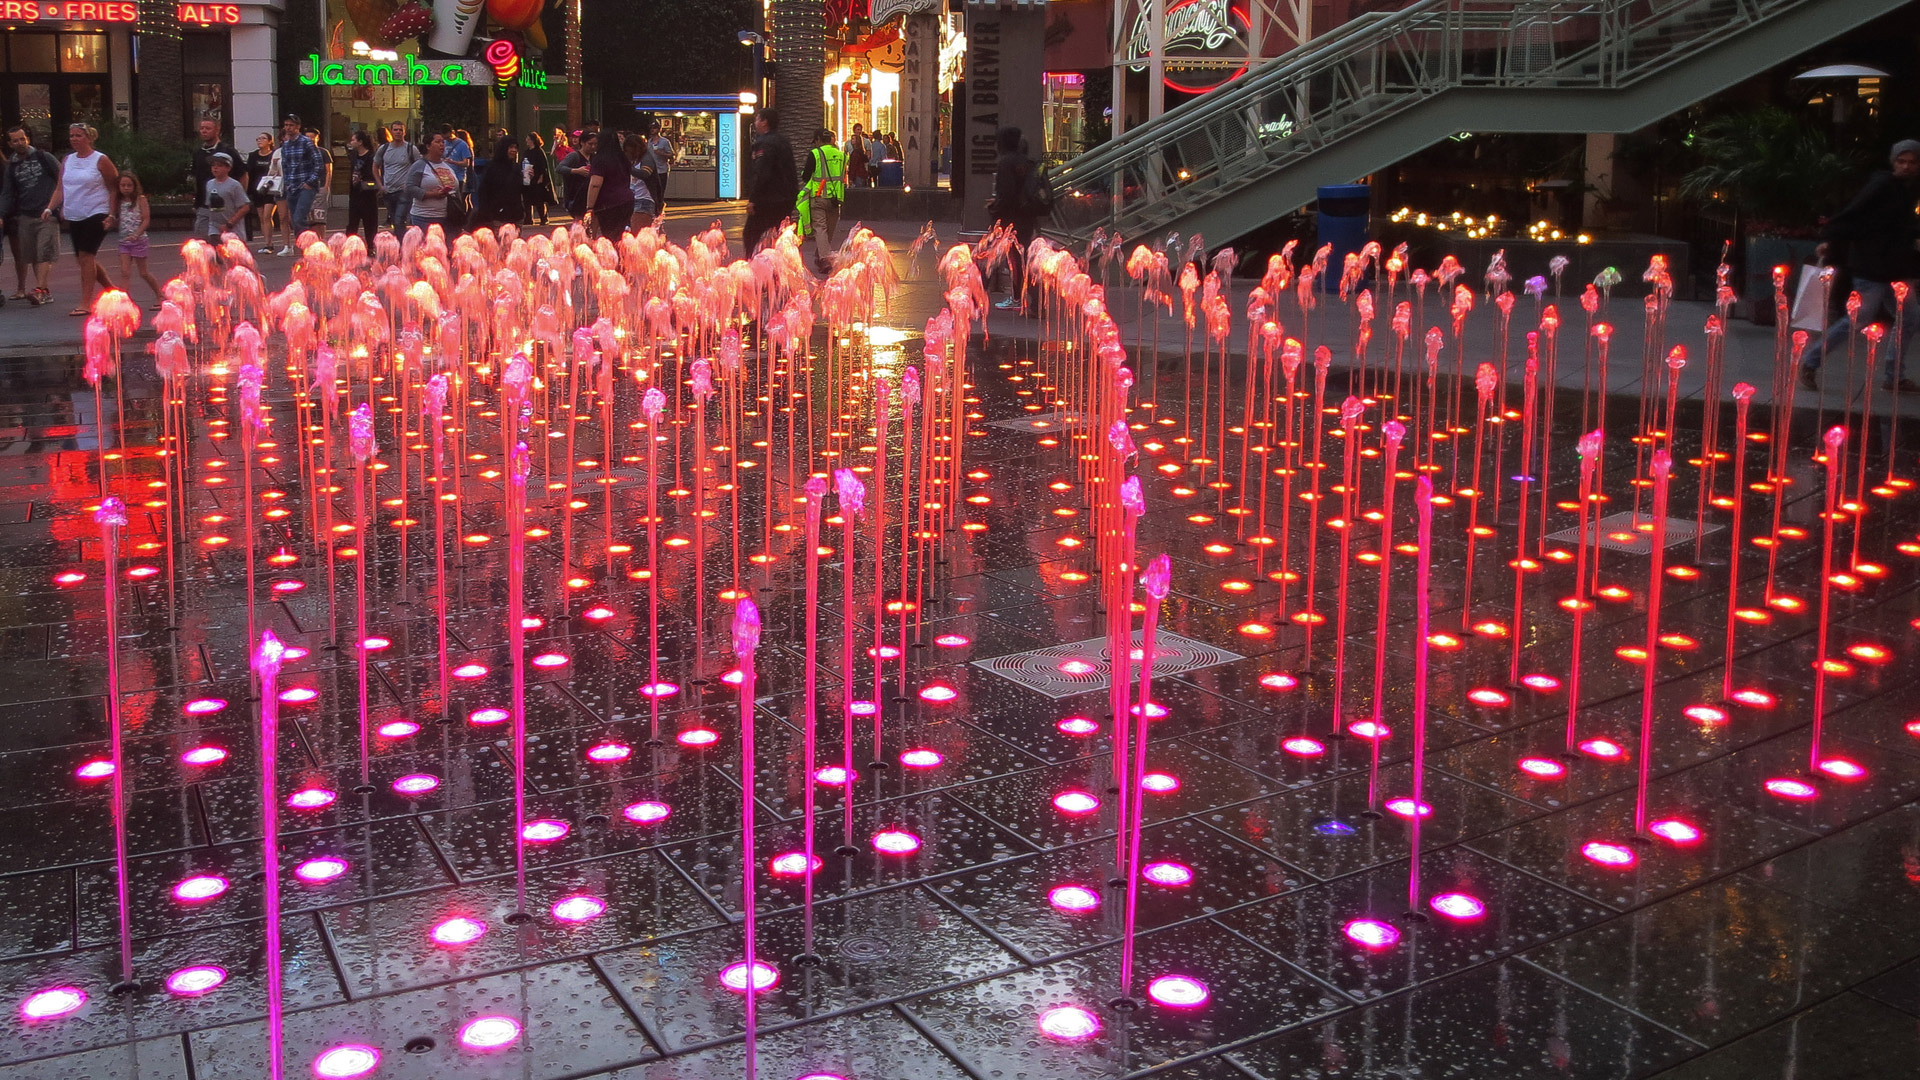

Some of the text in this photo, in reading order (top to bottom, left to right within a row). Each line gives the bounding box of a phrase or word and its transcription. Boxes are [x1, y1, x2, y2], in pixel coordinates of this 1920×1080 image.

[65, 2, 137, 22] FRIES
[178, 4, 240, 24] ALTS
[300, 54, 547, 90] Jamba Juice
[906, 20, 920, 150] CANTINA
[971, 22, 1000, 175] HUG A BREWER
[721, 123, 730, 188] PHOTOGRAPHS
